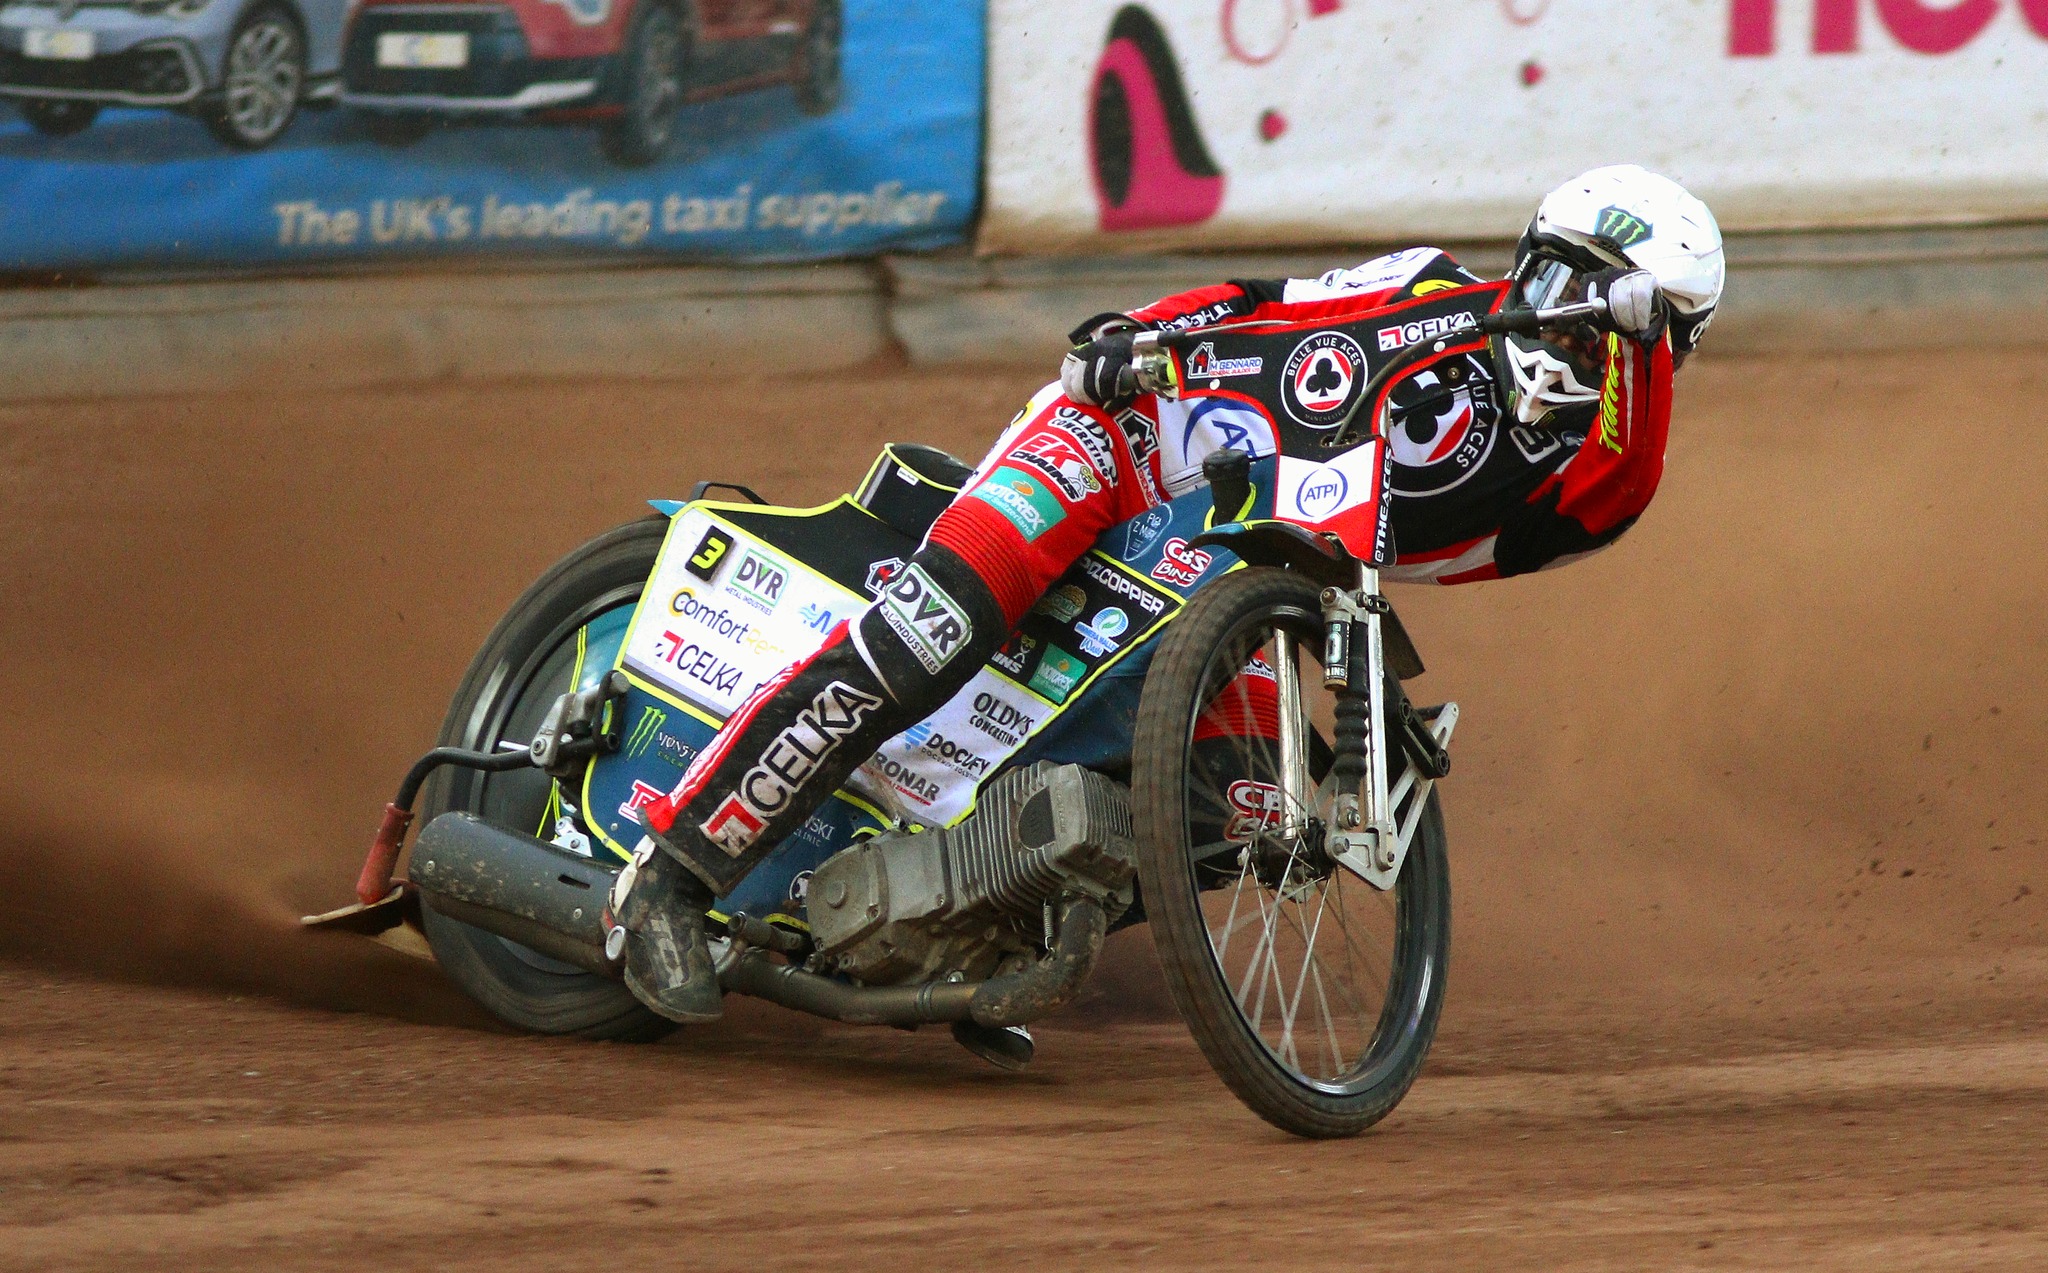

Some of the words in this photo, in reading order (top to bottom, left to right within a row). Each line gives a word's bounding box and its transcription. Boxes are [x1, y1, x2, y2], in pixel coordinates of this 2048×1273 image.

[275, 200, 359, 246] The
[369, 196, 471, 243] UK's
[480, 187, 651, 246] leading
[662, 184, 751, 236] taxi
[759, 180, 946, 237] supplier
[1219, 357, 1263, 369] GENNARD
[1287, 344, 1312, 377] BELLE
[1315, 336, 1338, 349] VUE
[1340, 339, 1362, 367] ACES
[1468, 371, 1490, 410] VUE
[1018, 435, 1079, 468] EK
[1456, 417, 1489, 468] ACES
[1010, 450, 1079, 500] CHAINS
[1304, 483, 1338, 502] ATPI
[980, 480, 1046, 531] MOTOREX
[691, 536, 727, 570] 3
[1157, 563, 1198, 583] BINS
[1167, 541, 1209, 575] CBS
[736, 554, 785, 602] DVR
[890, 572, 962, 656] DVR
[894, 619, 940, 674] INDUSTRIES
[677, 643, 744, 697] CELKA
[969, 714, 1019, 748] CONCRETING
[973, 692, 1035, 737] OLDY'S
[745, 685, 878, 813] CELKA
